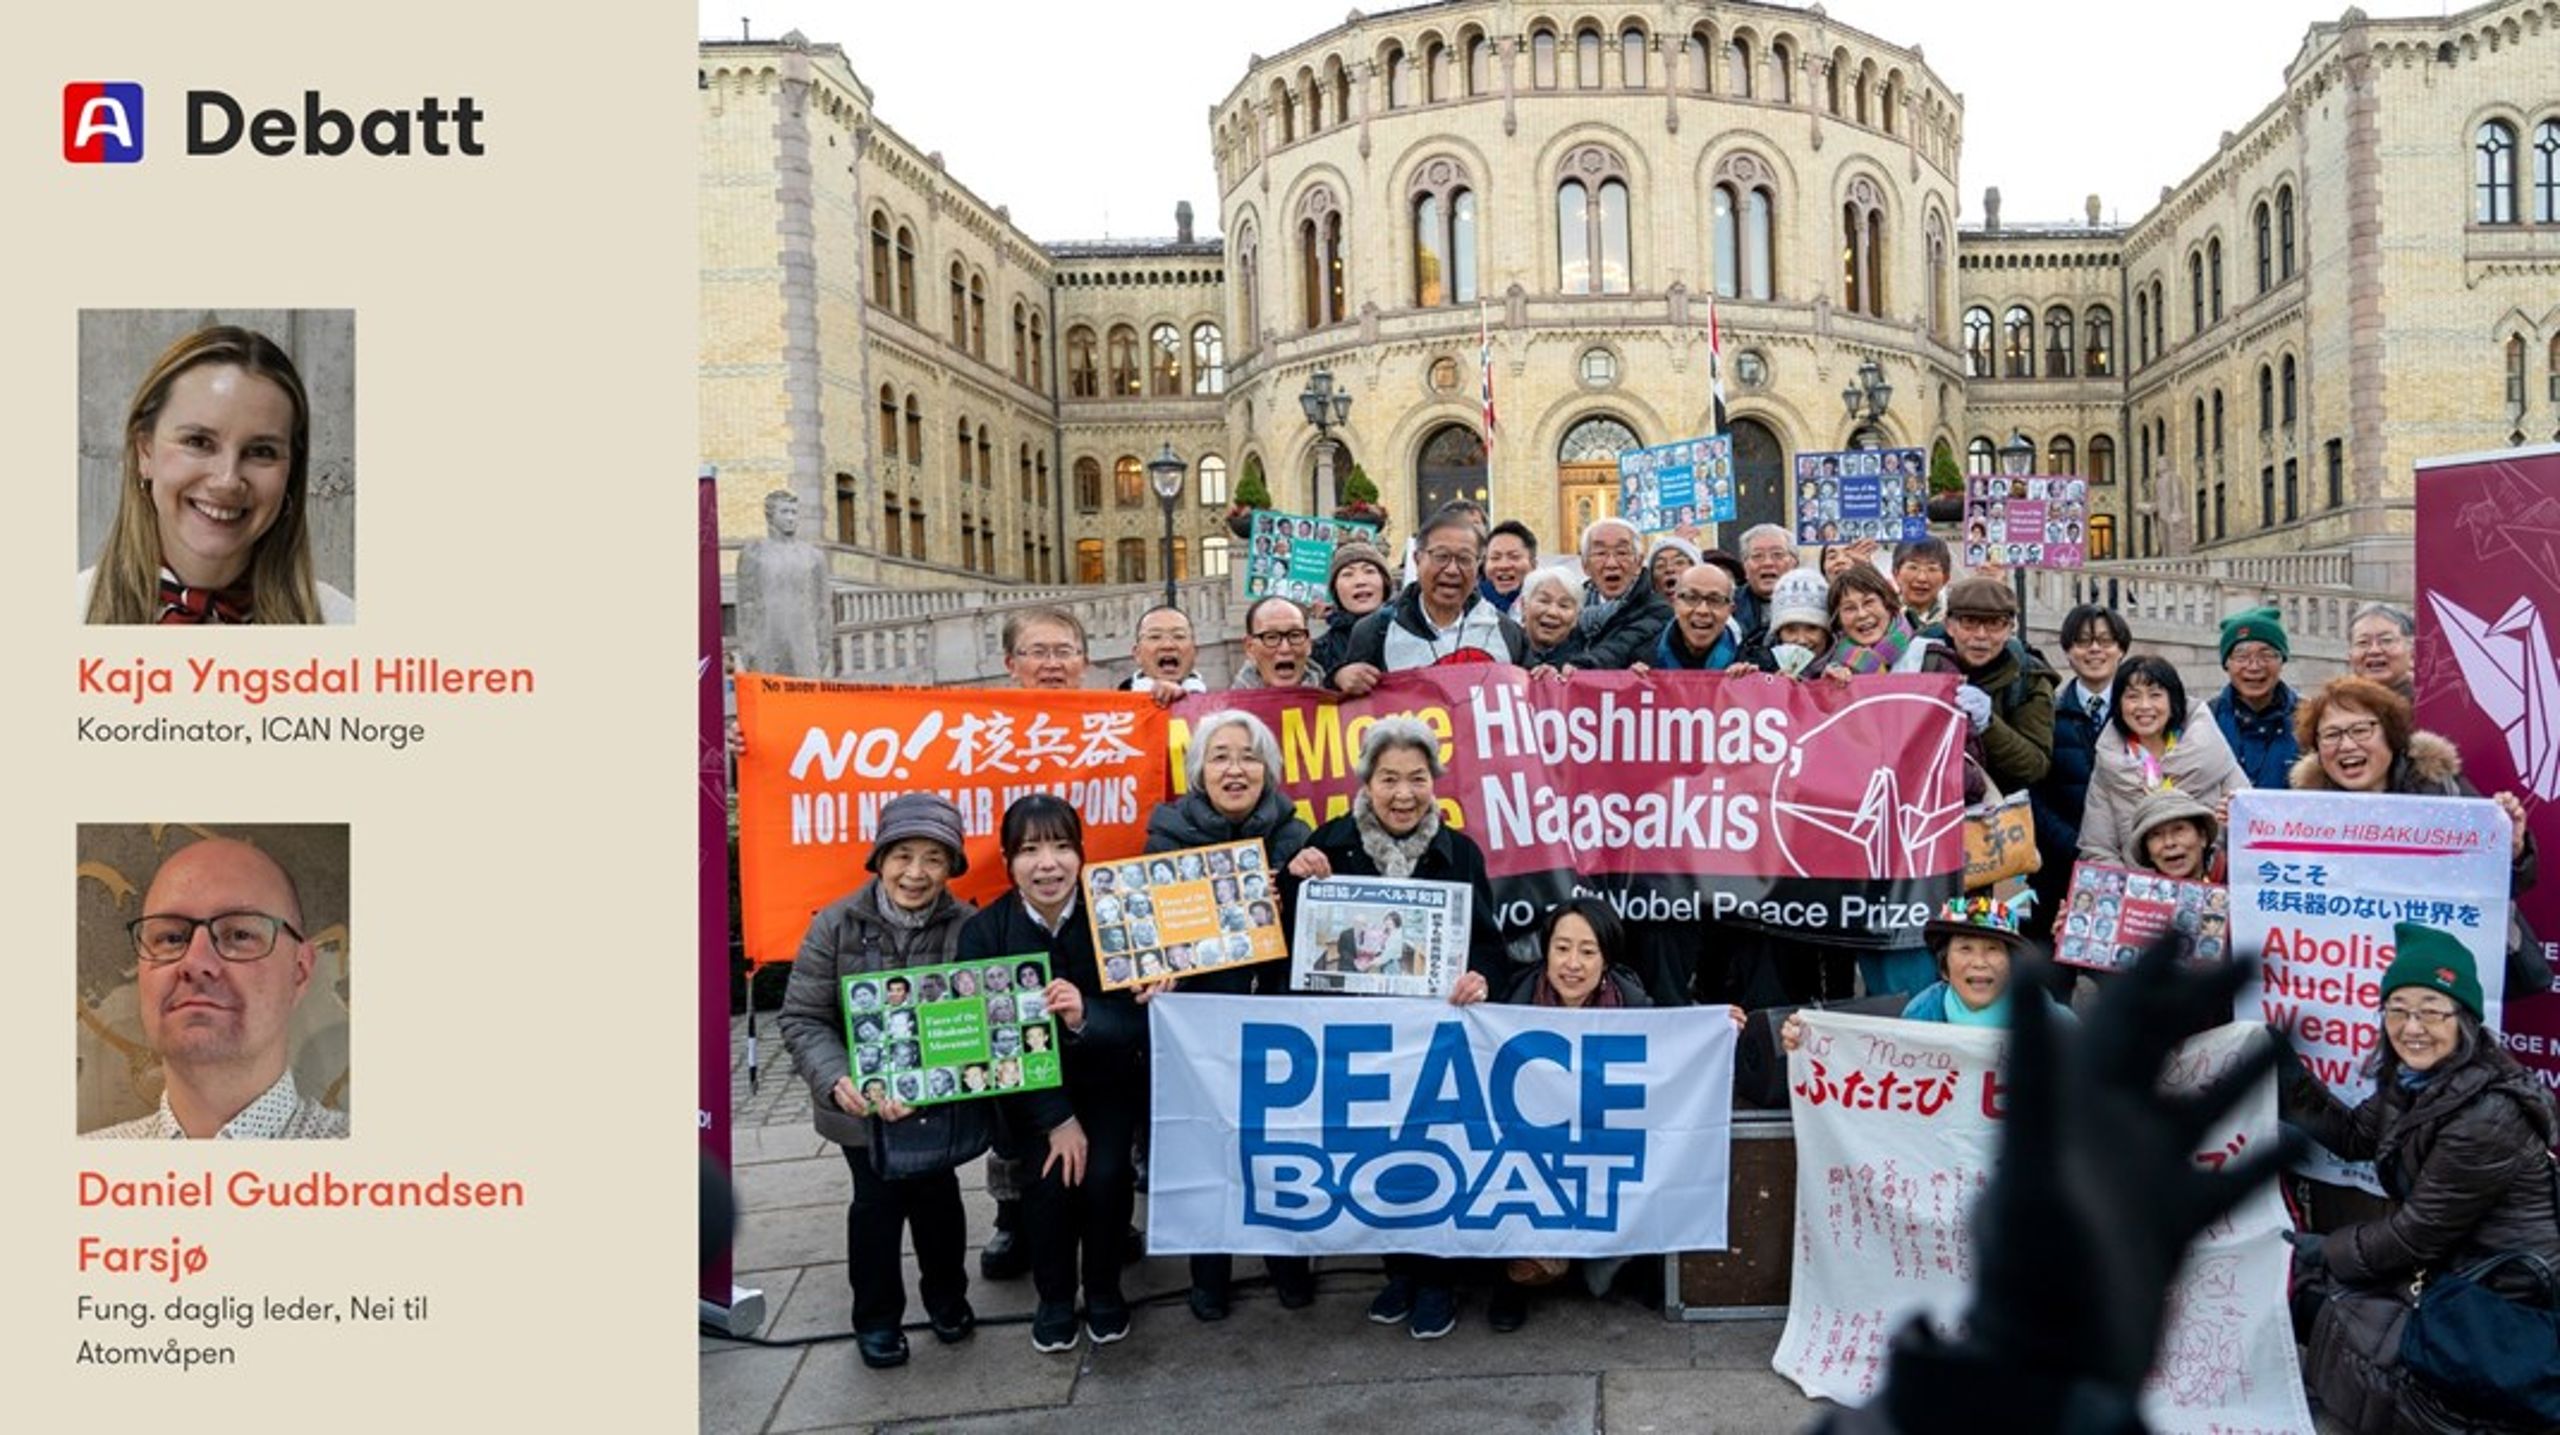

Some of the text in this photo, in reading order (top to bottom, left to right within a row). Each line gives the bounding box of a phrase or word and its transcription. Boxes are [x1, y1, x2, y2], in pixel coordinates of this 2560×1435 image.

[789, 710, 943, 781] NO!
[946, 710, 1146, 776] 核兵器
[1281, 704, 1454, 784] Moe
[791, 792, 848, 845] NO!
[2248, 819, 2276, 837] No
[2282, 821, 2337, 839] More
[2341, 823, 2480, 847] HIBAKUSHA
[2257, 860, 2329, 887] 今こそ
[1713, 892, 1829, 928] Peace
[1840, 895, 1931, 930] Prize
[2256, 888, 2481, 928] 核兵器のない世界を
[2261, 926, 2397, 970] Abolis
[2262, 962, 2382, 1010] Nucle
[2262, 1000, 2380, 1057] Weap
[1240, 1020, 1648, 1151] PEACE
[1795, 1058, 1960, 1117] ふたたび
[1247, 1145, 1640, 1225] BOAT
